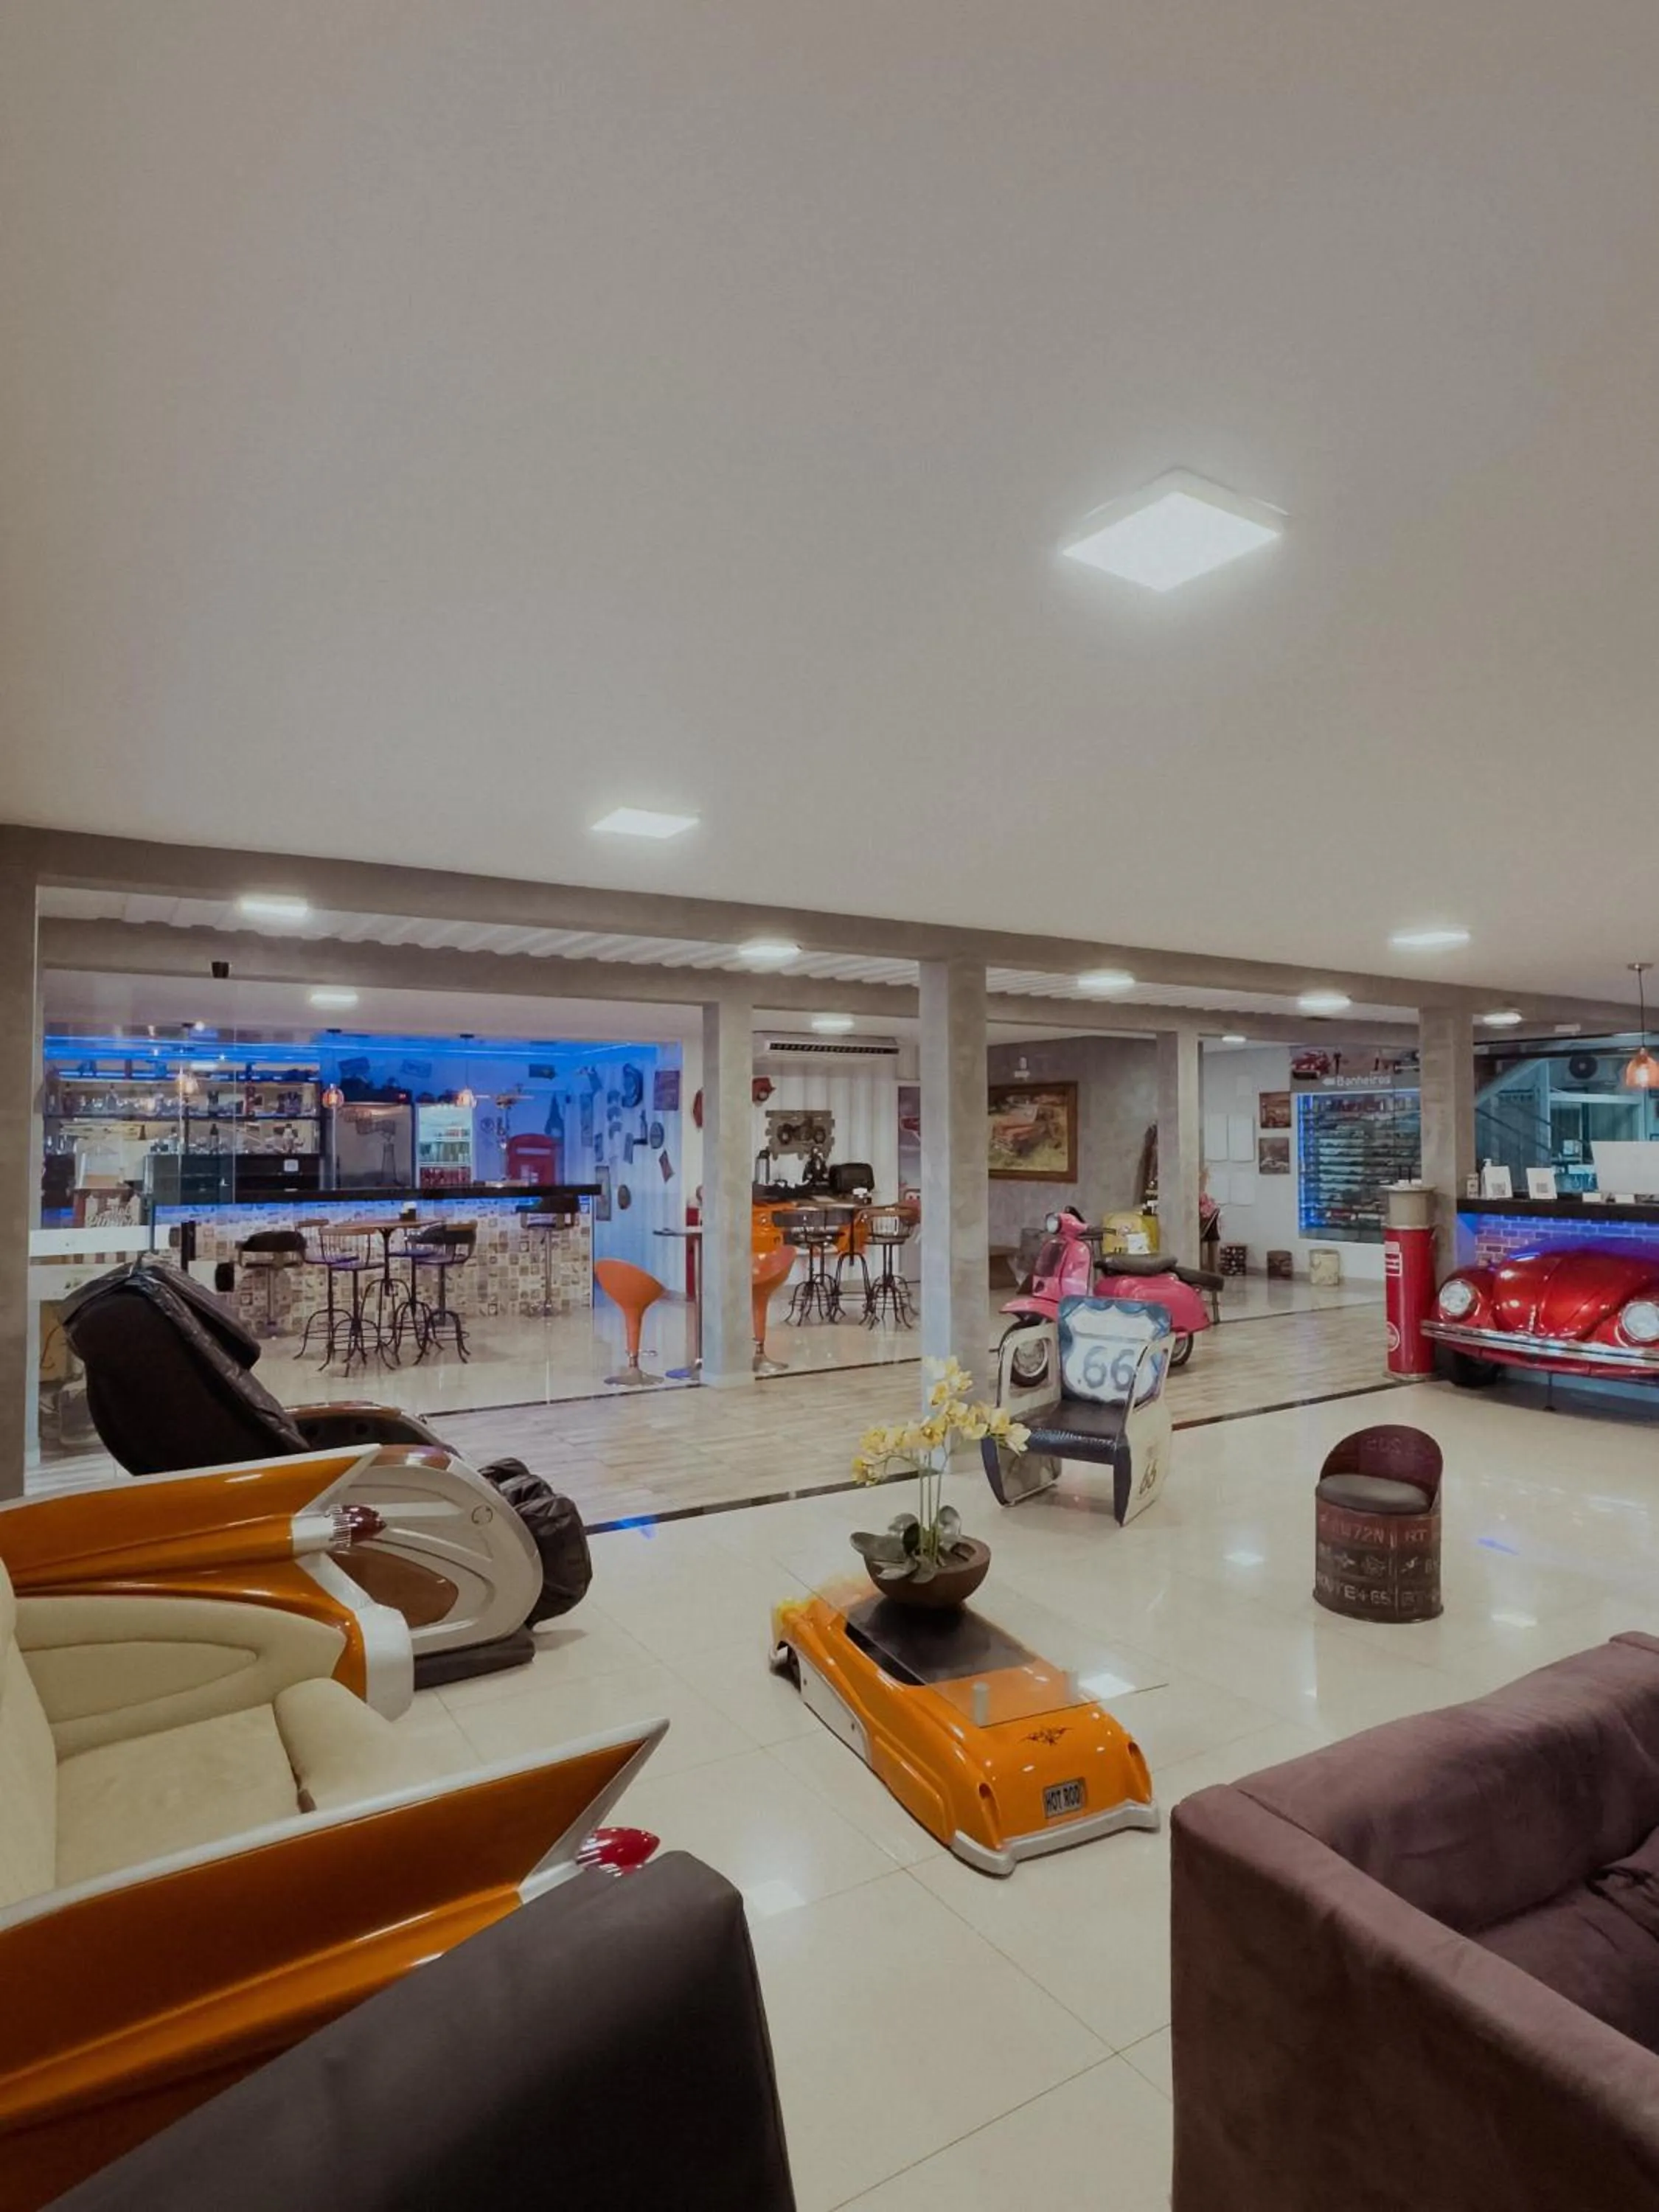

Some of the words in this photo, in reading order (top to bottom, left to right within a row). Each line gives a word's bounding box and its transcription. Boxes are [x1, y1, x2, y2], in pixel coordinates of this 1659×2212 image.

[1336, 1074, 1391, 1087] Banheiros
[1083, 1345, 1135, 1391] 66
[1046, 1789, 1062, 1812] HOT
